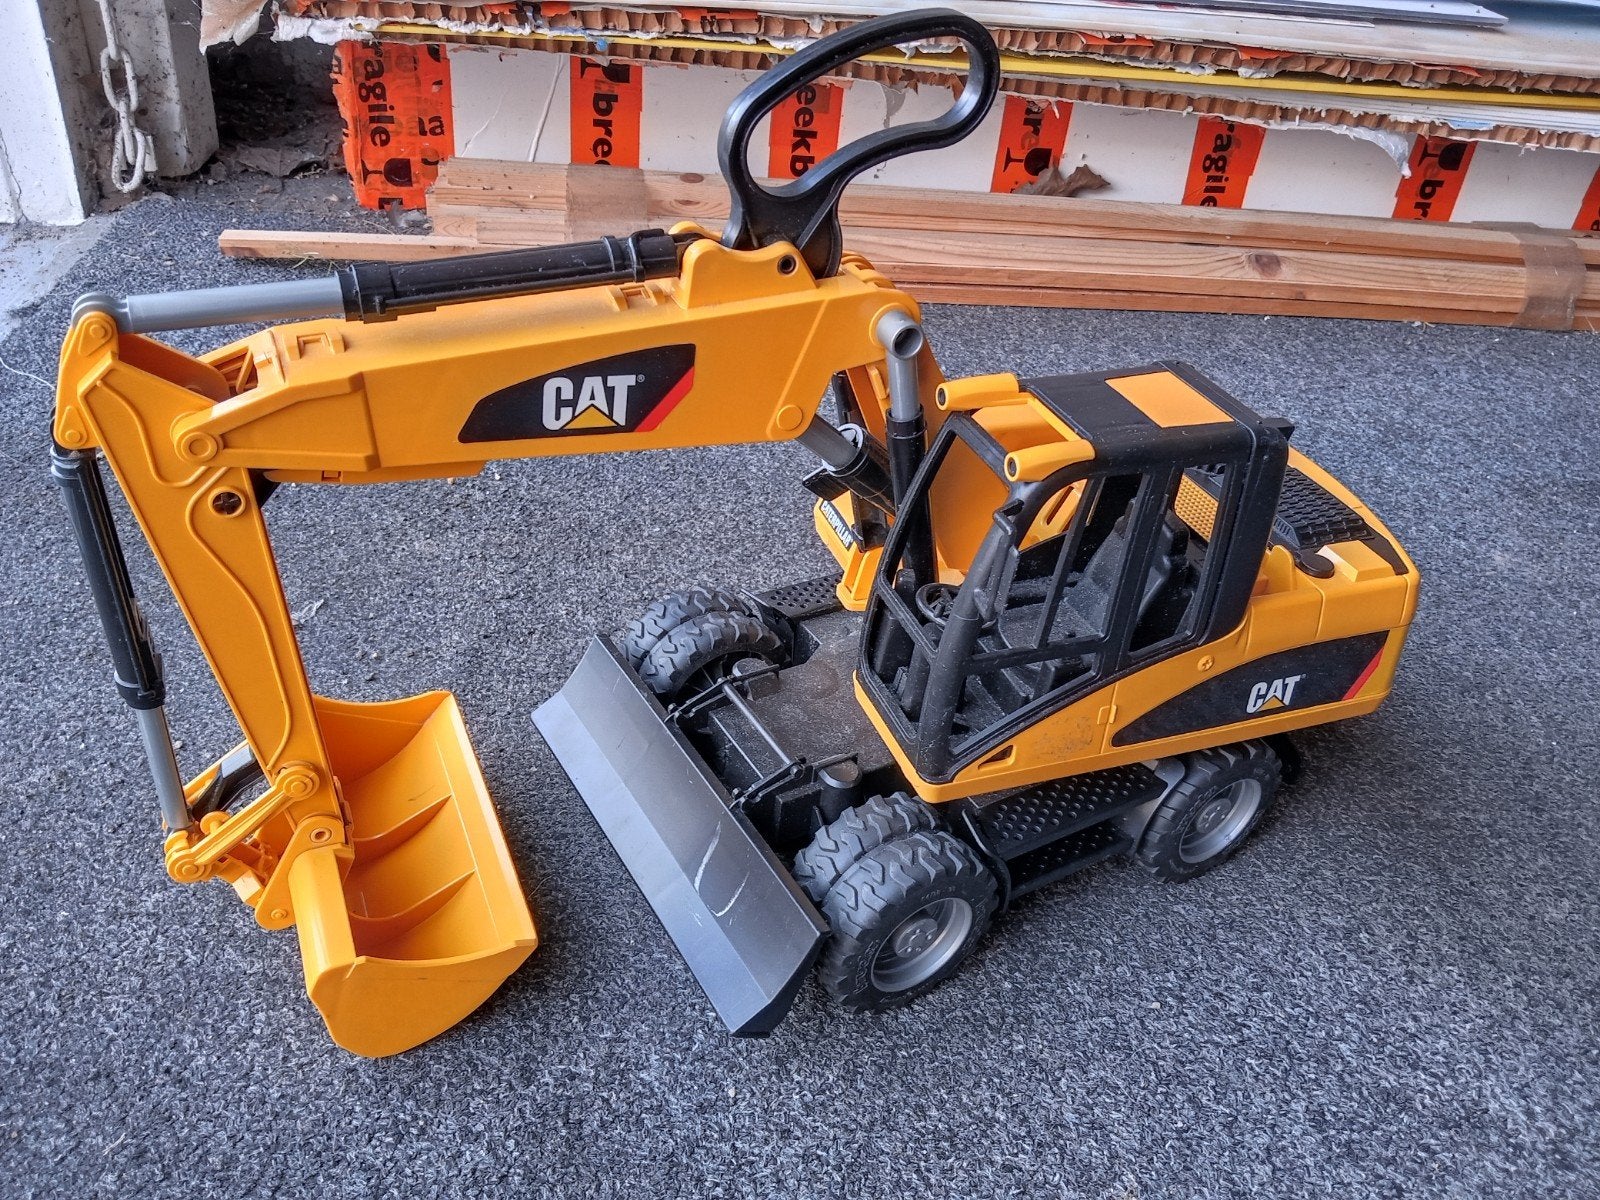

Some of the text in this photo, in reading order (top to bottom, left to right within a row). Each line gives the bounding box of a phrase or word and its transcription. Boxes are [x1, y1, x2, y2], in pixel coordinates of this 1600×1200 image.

[592, 93, 619, 165] bre
[820, 500, 854, 548] CATERPILLAR
[1246, 674, 1301, 714] CAT
